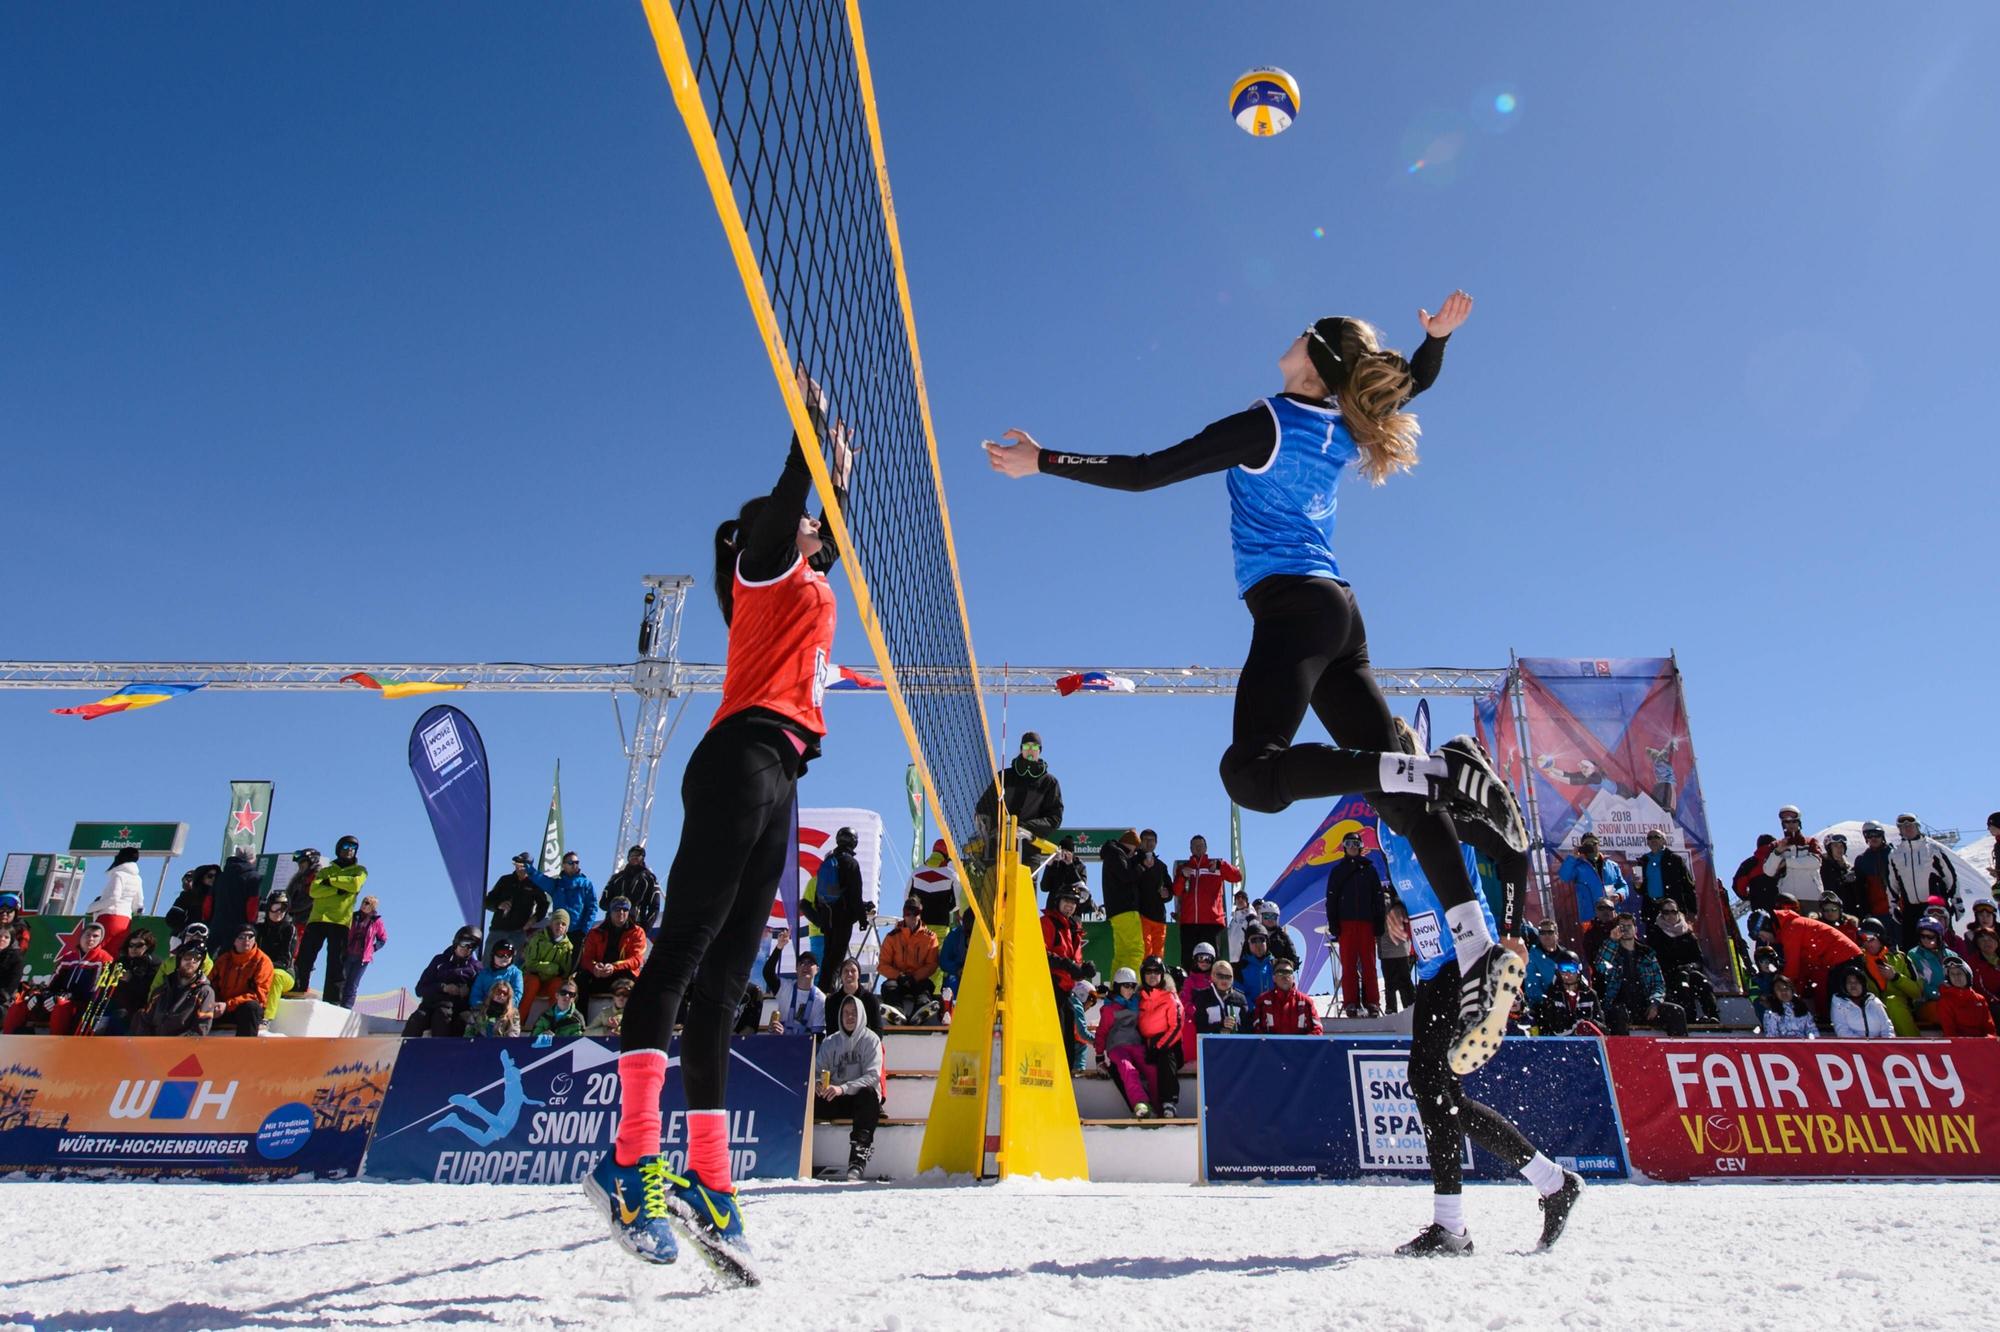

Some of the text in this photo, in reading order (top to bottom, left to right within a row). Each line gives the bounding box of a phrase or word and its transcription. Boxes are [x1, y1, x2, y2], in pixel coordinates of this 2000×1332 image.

[1611, 811, 1631, 822] 2018
[1597, 823, 1620, 835] SNOW
[100, 839, 144, 849] Heineken
[1413, 924, 1436, 937] SNOW
[1420, 937, 1439, 949] SPAC
[1368, 1069, 1405, 1079] FLAC
[1665, 1054, 1966, 1108] FAIR PLAY
[583, 1073, 623, 1105] 20
[1370, 1081, 1414, 1100] SNO
[549, 1097, 568, 1105] CEV
[1372, 1103, 1418, 1113] WAGR
[265, 1119, 309, 1131] Mit Tradition
[528, 1111, 604, 1144] SNOW
[1374, 1115, 1423, 1135] SPA
[272, 1130, 285, 1138] der
[1902, 1115, 1981, 1154] WAY
[58, 1135, 249, 1154] WÜRTH-HOCHENBURGER
[434, 1151, 568, 1185] EUROPEAN
[1215, 1163, 1316, 1173] www.snow-space.com
[1716, 1158, 1746, 1172] CEV
